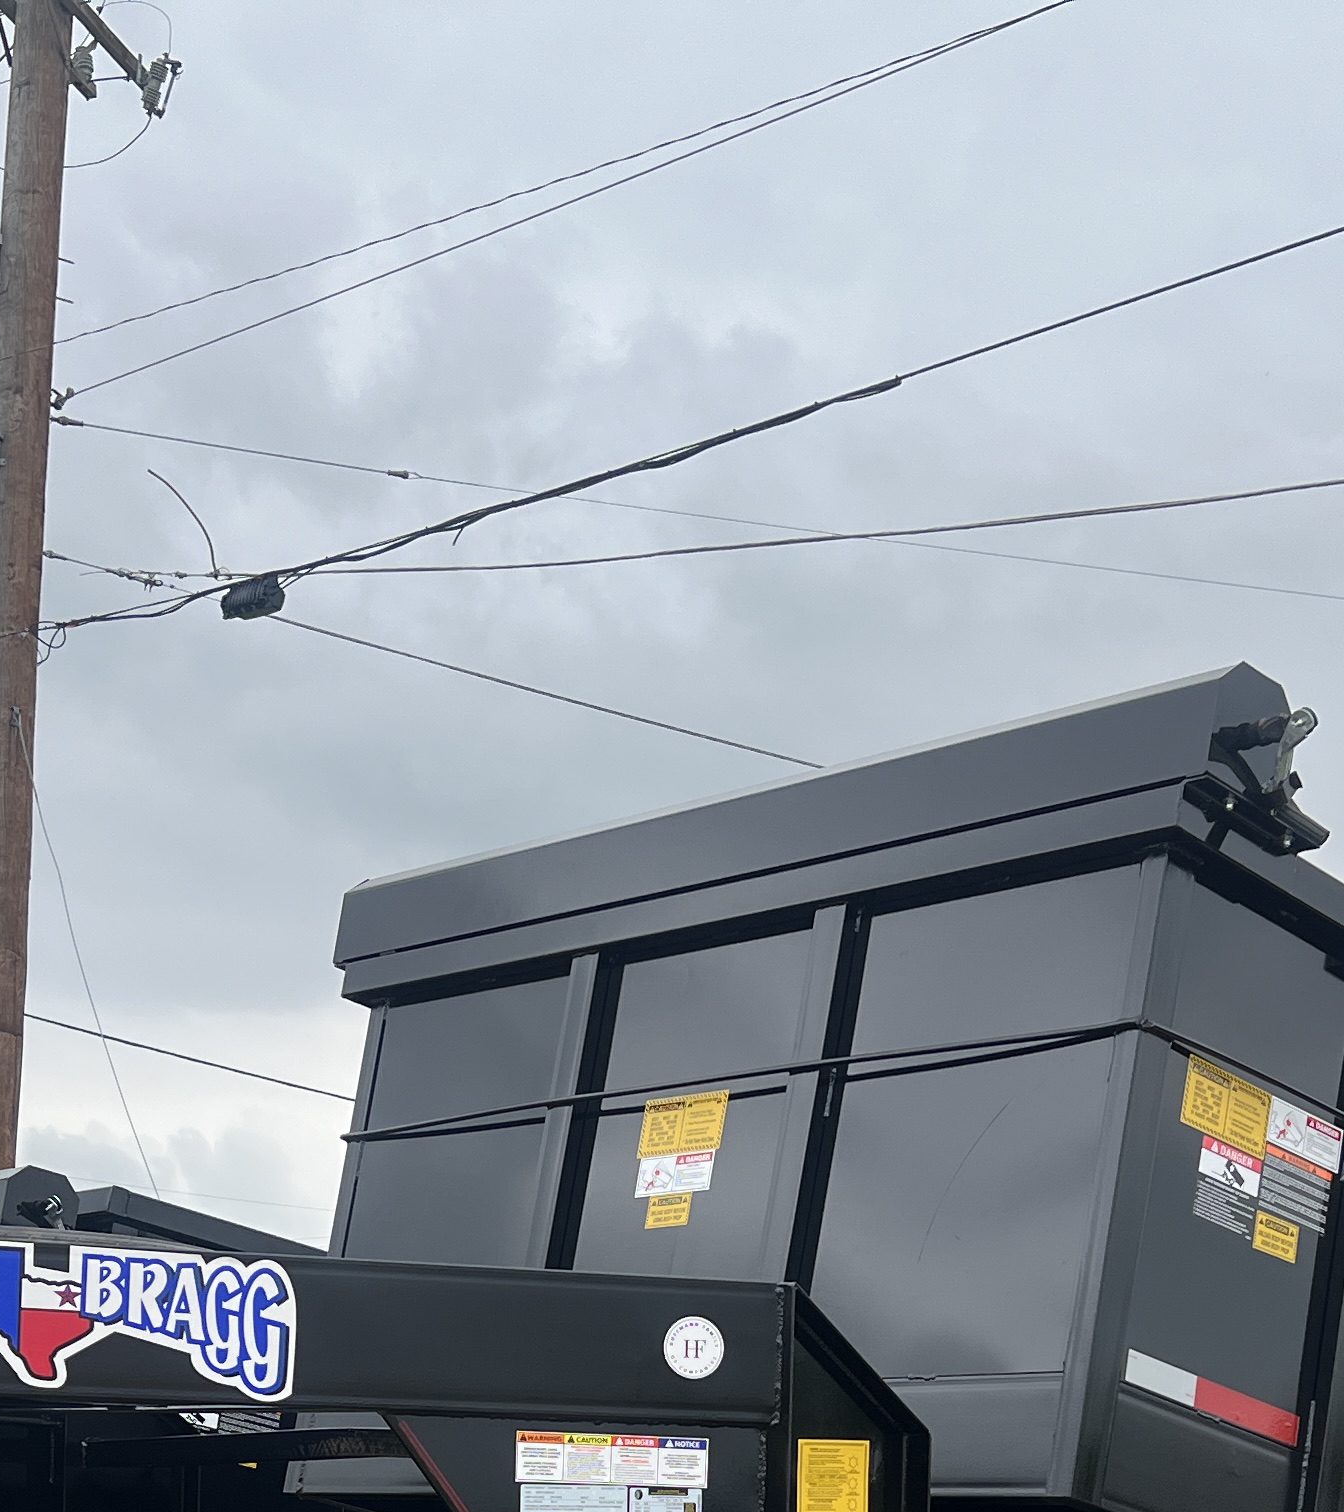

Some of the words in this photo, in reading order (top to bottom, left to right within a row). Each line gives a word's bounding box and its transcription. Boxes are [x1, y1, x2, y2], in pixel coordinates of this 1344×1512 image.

[1315, 1121, 1341, 1140] DANGER
[1219, 1147, 1254, 1168] DANGER
[1266, 1220, 1289, 1234] CAUTION
[80, 1252, 291, 1396] BRAGG
[683, 1339, 707, 1359] HF
[527, 1434, 562, 1442] WARNING
[576, 1436, 609, 1444] CAUTION
[624, 1438, 655, 1447] DANGER
[674, 1440, 701, 1449] NOTICE
